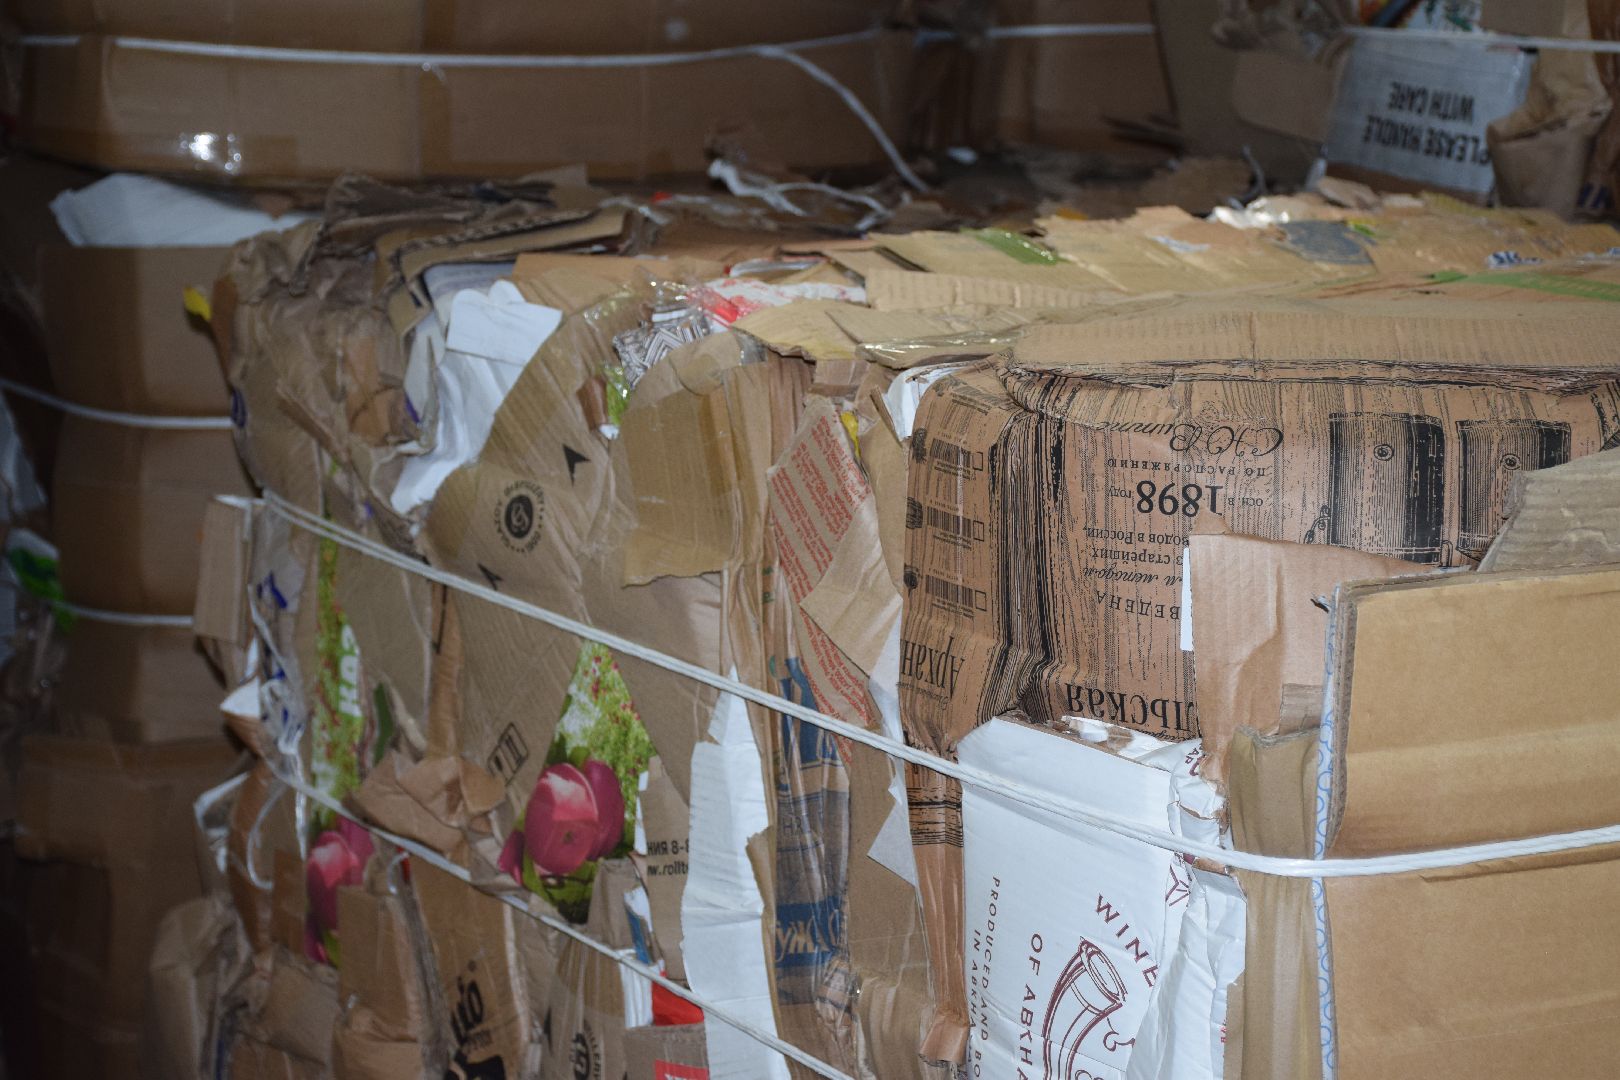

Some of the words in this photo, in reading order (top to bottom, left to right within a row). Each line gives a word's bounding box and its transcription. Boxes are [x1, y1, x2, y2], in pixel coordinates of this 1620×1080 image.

[1388, 81, 1428, 115] CARE
[1428, 89, 1474, 124] WITH
[1363, 114, 1422, 151] HANDLE
[1107, 458, 1235, 476] РАСПОРЯЖЕНИЮ
[1244, 467, 1265, 477] ПО
[1108, 486, 1132, 499] году
[1136, 480, 1224, 518] 1898
[1137, 533, 1144, 542] в
[1091, 547, 1171, 565] старейших
[1083, 562, 1159, 585] методом
[1096, 590, 1181, 620] ВЕДЕНА
[973, 929, 981, 952] IN
[981, 876, 1001, 990] PRODUCED
[1096, 893, 1159, 987] WINE
[1028, 933, 1043, 975] OF
[981, 998, 989, 1041] AND
